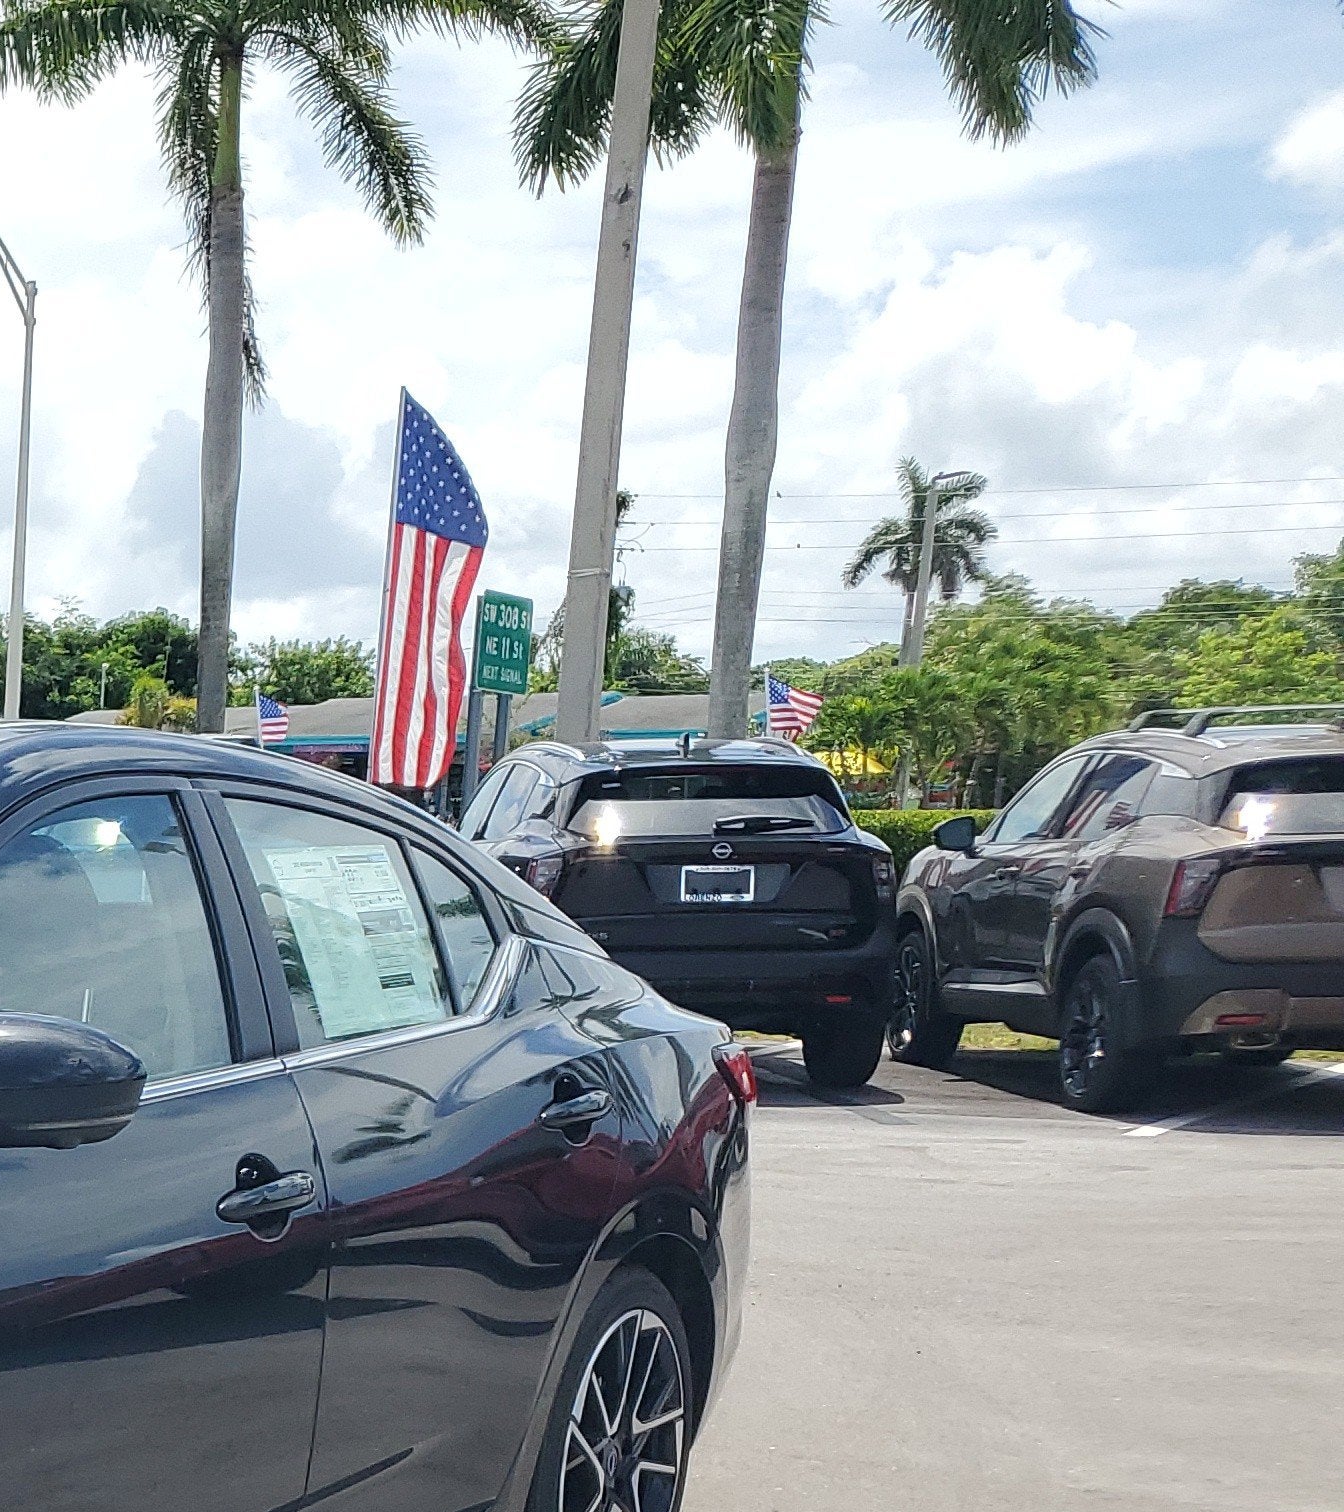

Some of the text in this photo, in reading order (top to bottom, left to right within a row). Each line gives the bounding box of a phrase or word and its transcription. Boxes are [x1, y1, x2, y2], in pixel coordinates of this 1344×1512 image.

[483, 602, 498, 623] SW
[498, 604, 519, 631] 308
[485, 635, 524, 660] NE 11 St
[482, 665, 522, 685] NEXT SIGNAL
